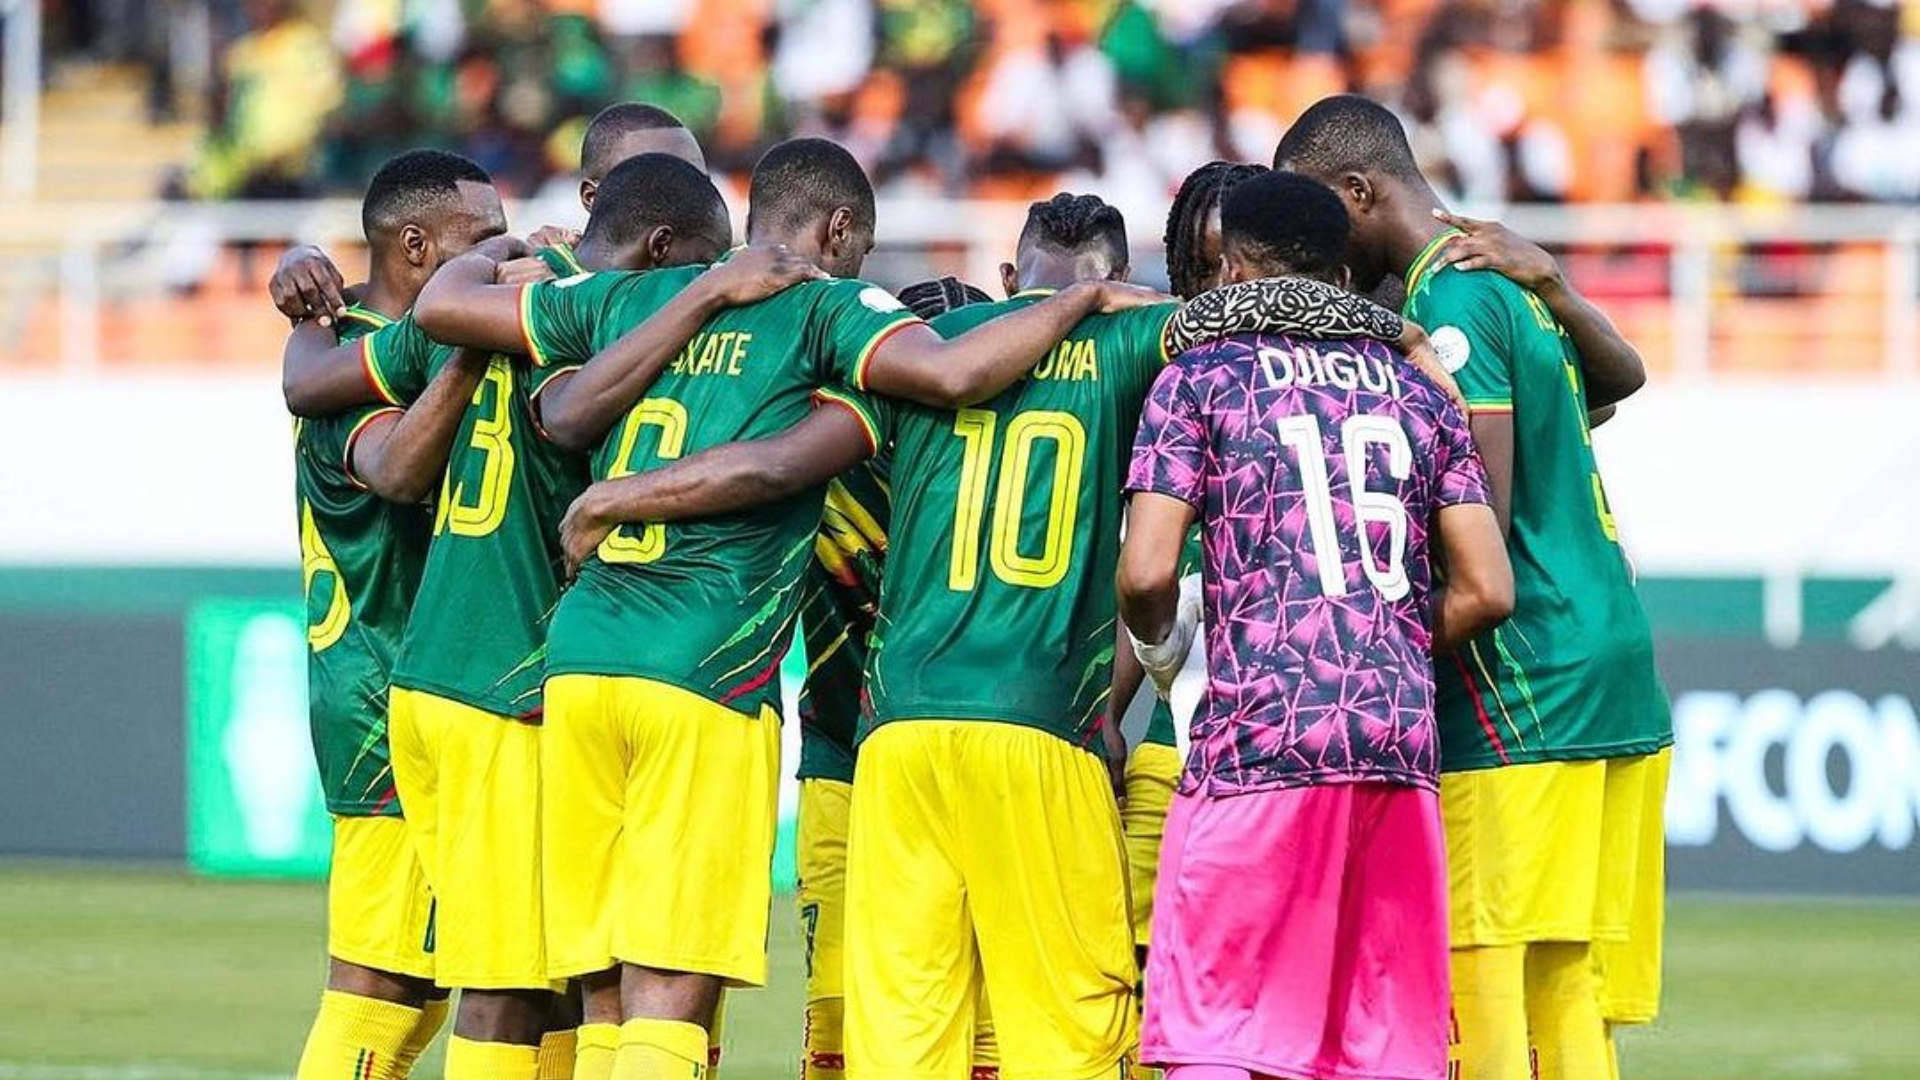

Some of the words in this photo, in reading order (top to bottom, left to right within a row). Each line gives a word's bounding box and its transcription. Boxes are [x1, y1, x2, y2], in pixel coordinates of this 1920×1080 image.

[1033, 338, 1098, 381] UMA
[1258, 346, 1401, 402] DJIGUI
[597, 397, 689, 565] 6
[949, 409, 1086, 592] 10
[1277, 413, 1413, 601] 16
[1664, 686, 1920, 853] FCON
